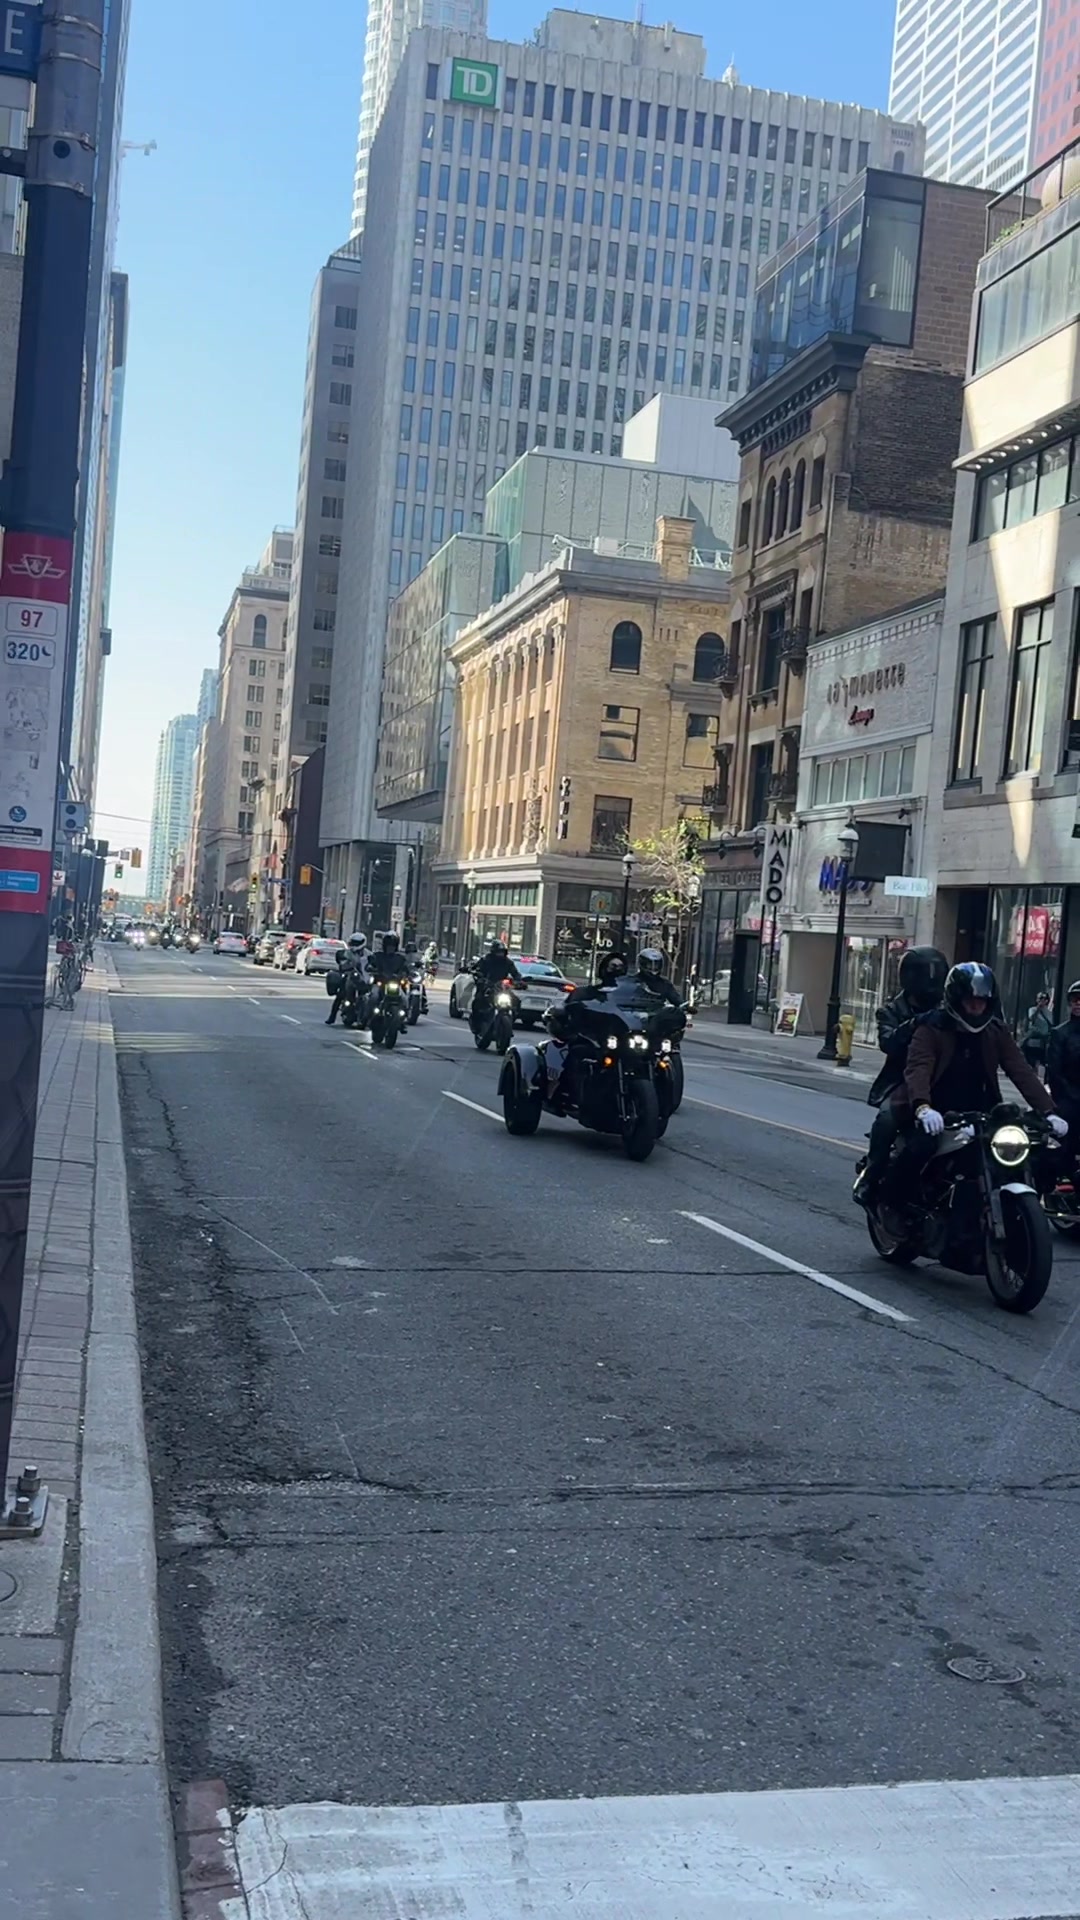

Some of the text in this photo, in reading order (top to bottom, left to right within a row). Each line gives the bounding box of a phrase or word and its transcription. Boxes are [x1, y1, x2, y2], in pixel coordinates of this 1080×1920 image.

[4, 9, 25, 55] E
[456, 66, 492, 97] TD
[21, 610, 43, 628] 97
[7, 641, 39, 661] 320
[766, 829, 787, 904] MADO
